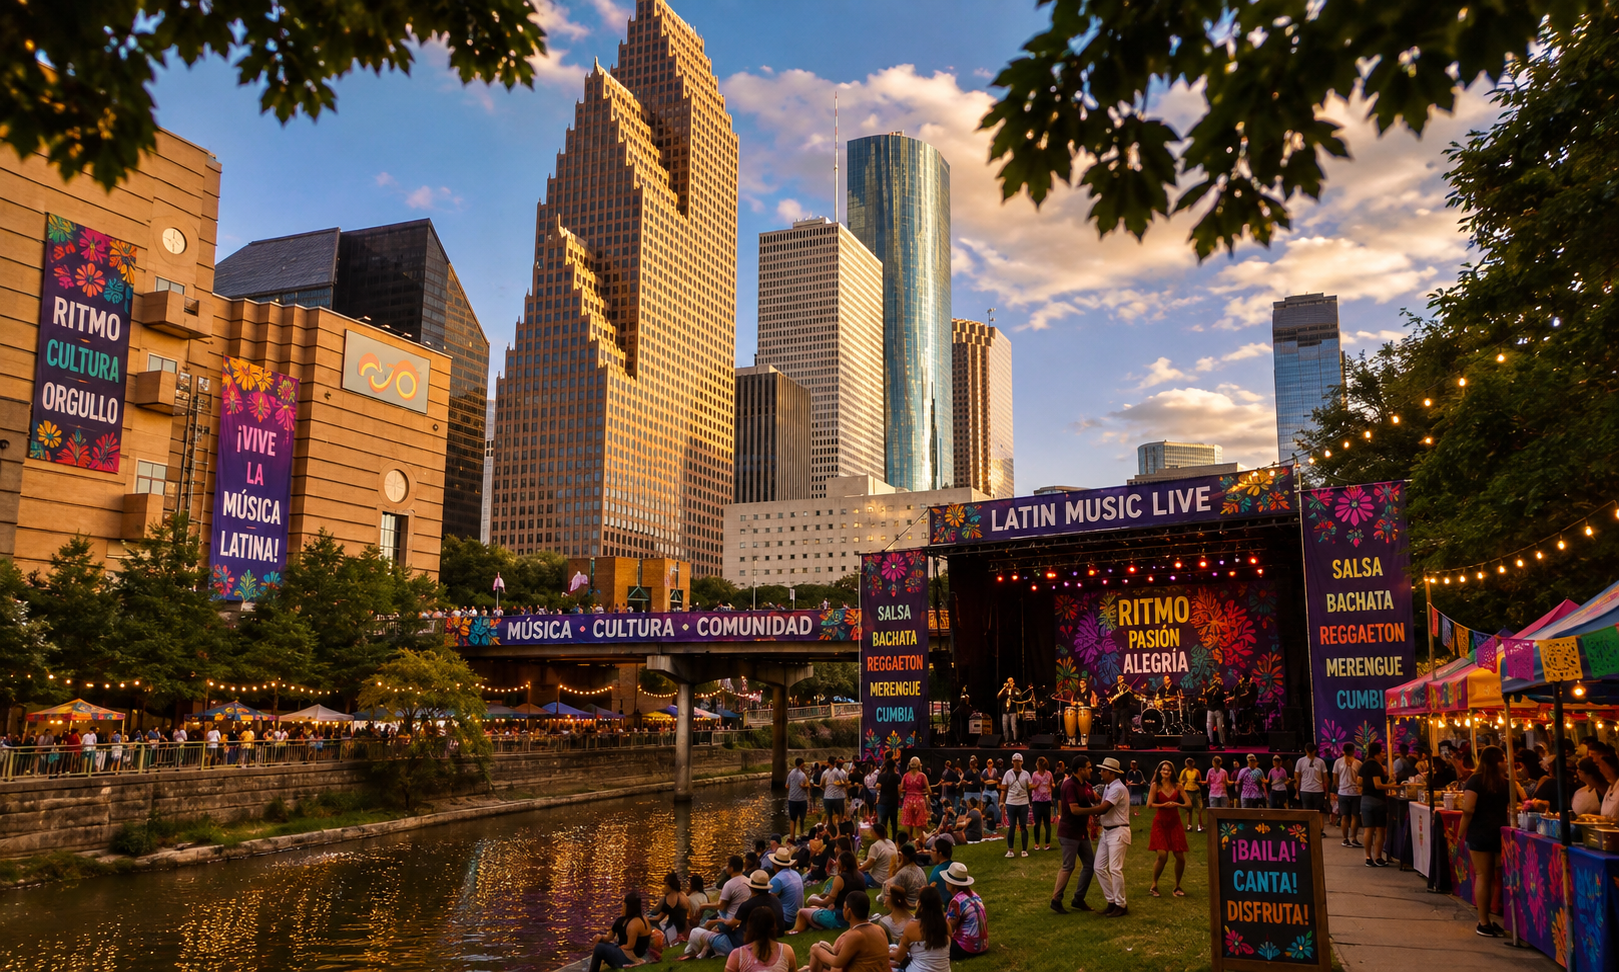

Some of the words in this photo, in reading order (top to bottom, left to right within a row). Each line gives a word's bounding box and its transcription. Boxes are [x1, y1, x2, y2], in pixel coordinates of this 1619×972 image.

[52, 295, 121, 342] RITMO
[46, 338, 120, 383] CULTURA
[42, 381, 119, 425] ORGULLO
[236, 424, 277, 457] ¡VIVE
[246, 461, 264, 486] LA
[222, 489, 282, 526] MÚSICA
[991, 502, 1057, 532] LATIN
[1065, 493, 1142, 523] MUSIC
[1152, 485, 1211, 514] LIVE
[219, 530, 279, 563] LATINA!
[1332, 556, 1384, 579] SALSA
[877, 604, 912, 621] SALSA
[1118, 596, 1190, 627] RITMO
[1326, 590, 1395, 613] BACHATA
[506, 617, 573, 640] MÚSICA
[592, 618, 675, 638] CULTURA
[696, 615, 813, 637] COMUNIDAD
[872, 630, 918, 647] BACHATA
[1128, 624, 1180, 648] PASIÓN
[1319, 622, 1406, 645] REGGAETON
[866, 654, 924, 672] REGGAETON
[1123, 648, 1189, 674] ALEGRÍA
[1325, 656, 1404, 677] MERENGUE
[869, 681, 921, 697] MERENGUE
[1336, 689, 1384, 710] CUMBI
[876, 706, 915, 722] CUMBIA
[1231, 839, 1297, 863] ¡BAILA!
[1233, 869, 1298, 894] CANTA!
[1226, 900, 1310, 926] DISFRUTA!
